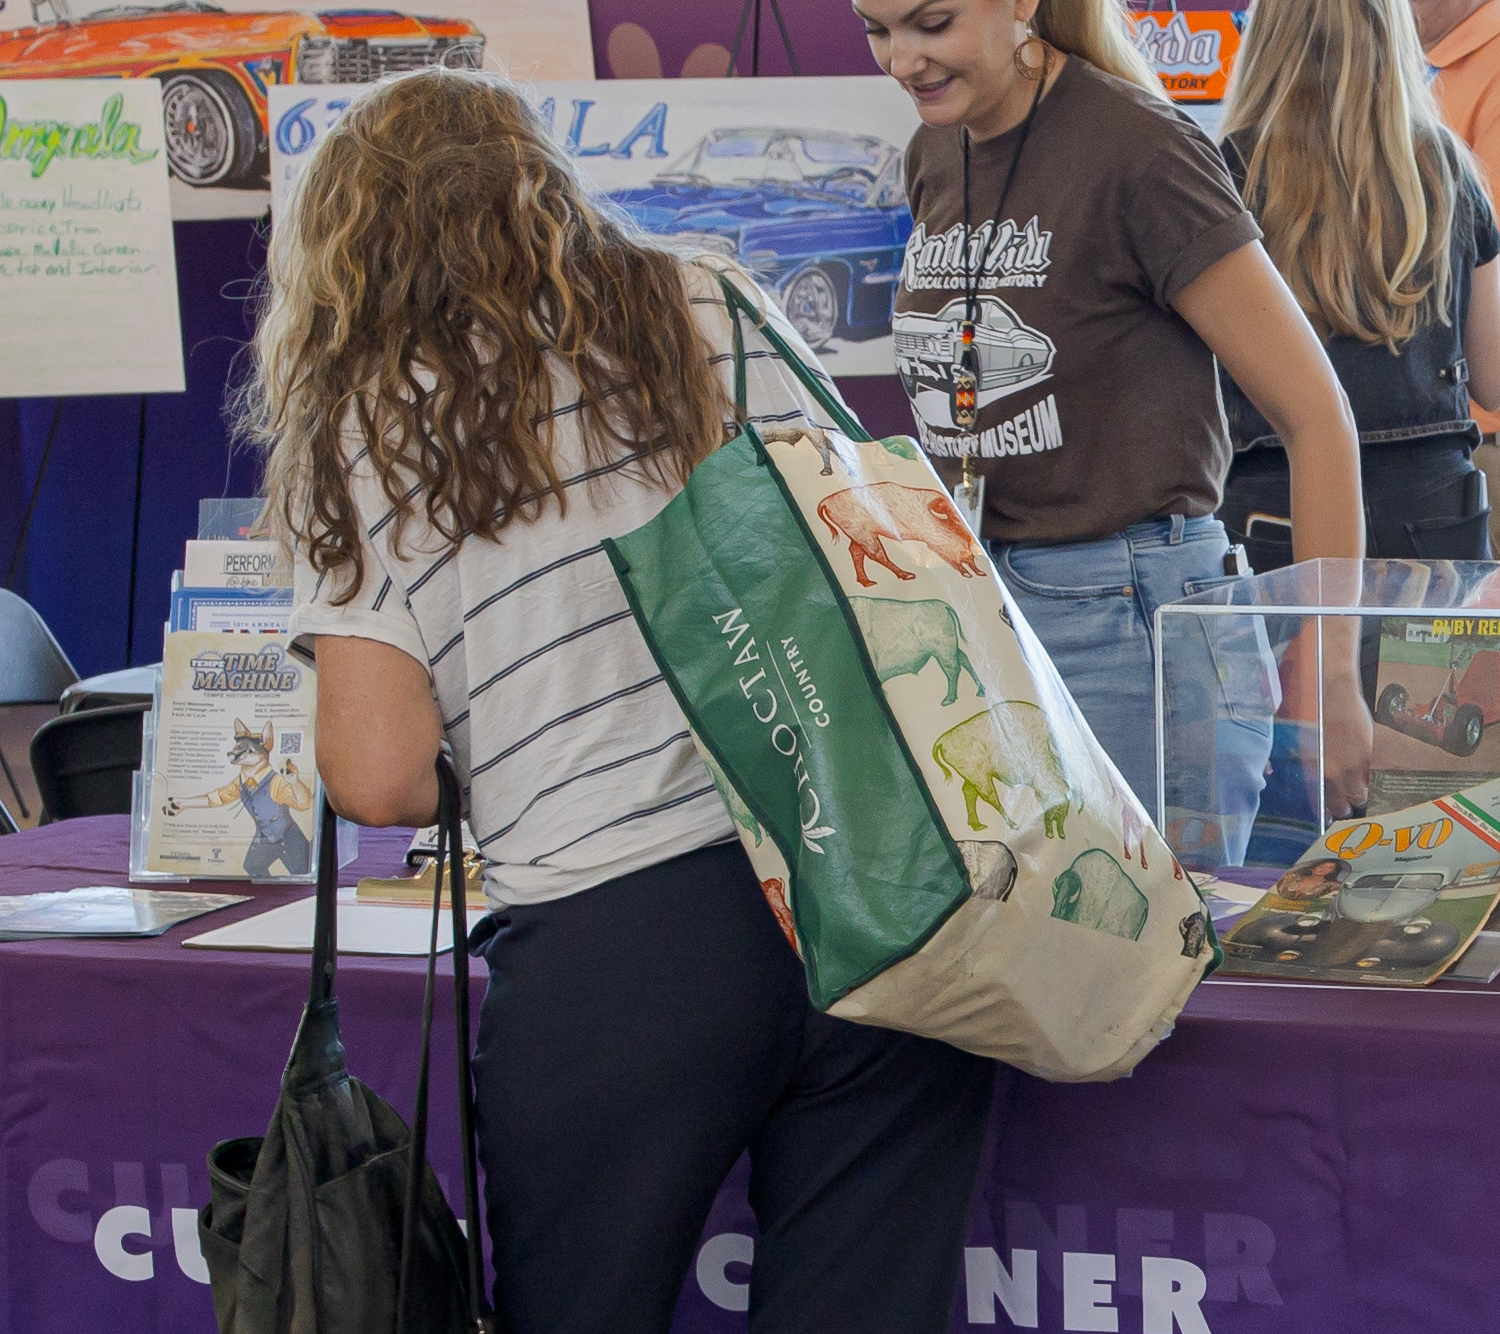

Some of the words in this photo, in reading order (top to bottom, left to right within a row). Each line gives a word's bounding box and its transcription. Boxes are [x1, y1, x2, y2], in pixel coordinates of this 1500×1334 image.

[979, 394, 1063, 458] MUSEUM
[1433, 618, 1474, 636] RUBY
[224, 652, 279, 672] TIME
[192, 671, 296, 692] MACHINE
[780, 636, 830, 728] COUNTRY
